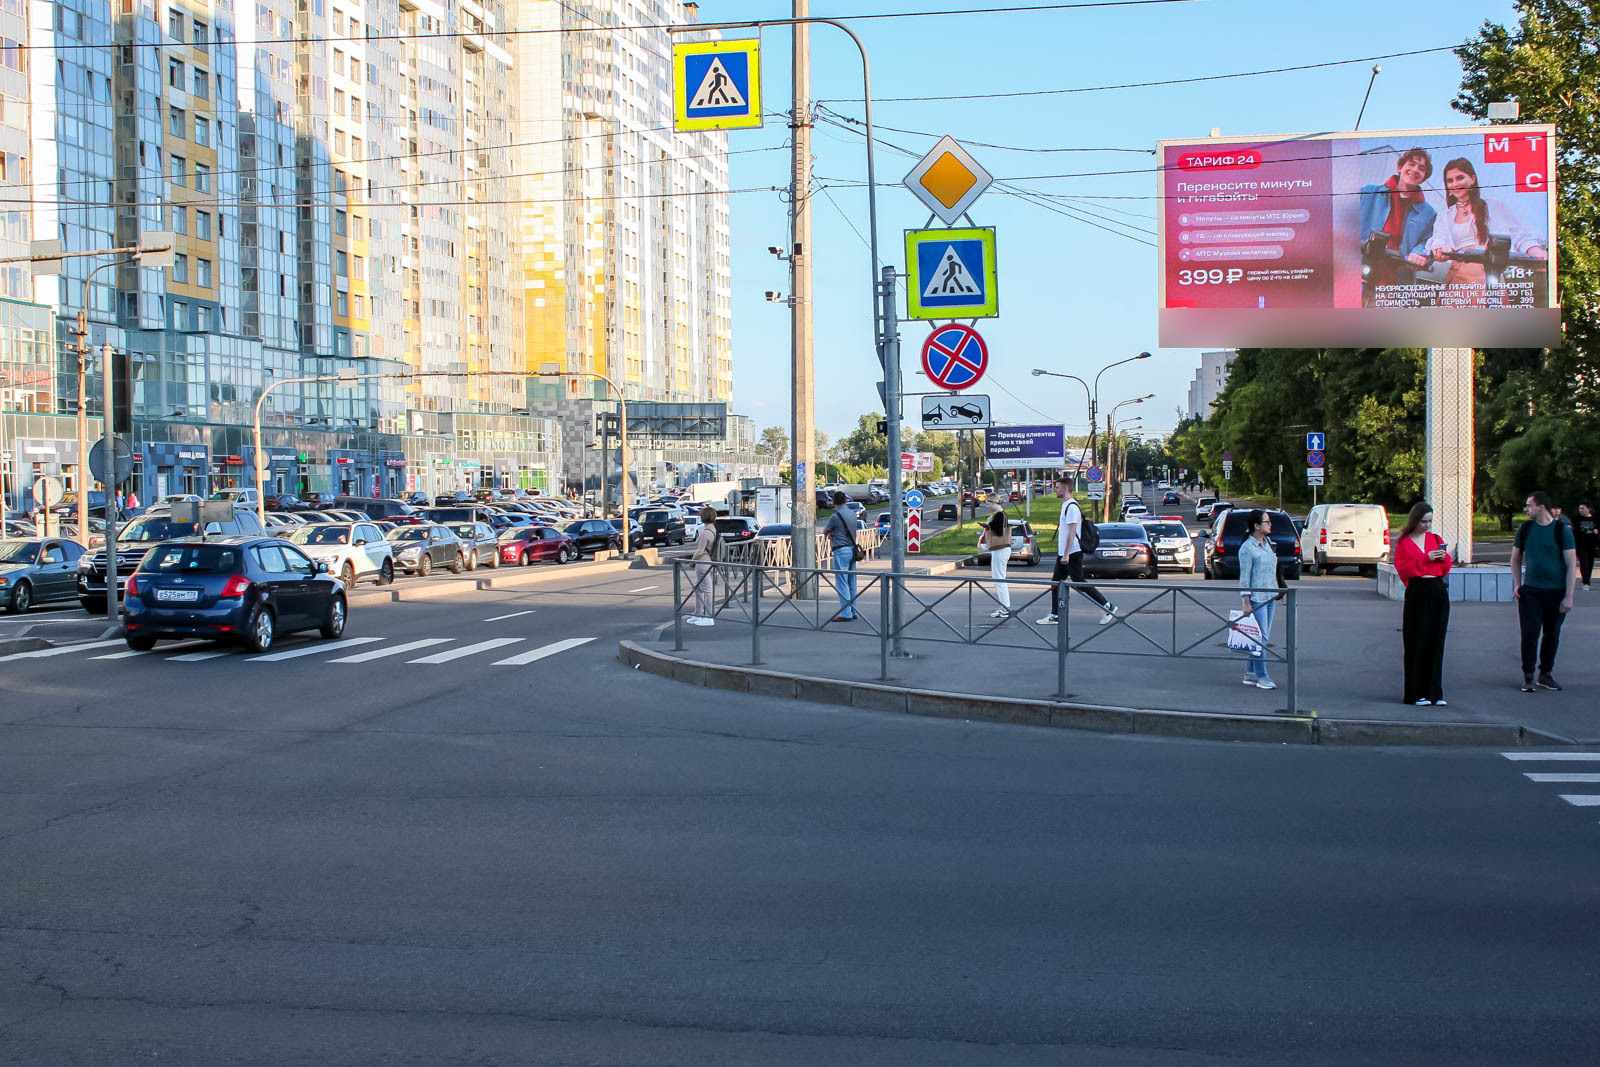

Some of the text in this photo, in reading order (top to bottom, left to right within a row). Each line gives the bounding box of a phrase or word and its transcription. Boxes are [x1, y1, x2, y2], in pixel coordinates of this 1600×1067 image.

[1488, 136, 1542, 152] М Т
[1186, 154, 1255, 167] ТАРИФ 24
[1177, 178, 1312, 193] Переносите минуты
[1525, 173, 1543, 188] С
[1177, 192, 1258, 204] и гигабайты
[1388, 290, 1436, 299] СЛЕДУЮЩИЙ
[1438, 290, 1465, 298] МЕСЯЦ
[1467, 289, 1479, 297] (НЕ
[1482, 289, 1505, 297] БОЛЕЕ
[1375, 298, 1420, 307] СТОИМОСТЬ
[1430, 298, 1436, 306] В
[1441, 296, 1472, 305] ПЕРВЫЙ
[1477, 296, 1503, 305] МЕСЯЦ
[1520, 296, 1534, 304] 399
[998, 431, 1025, 439] Приведу
[990, 445, 1021, 454] парадной
